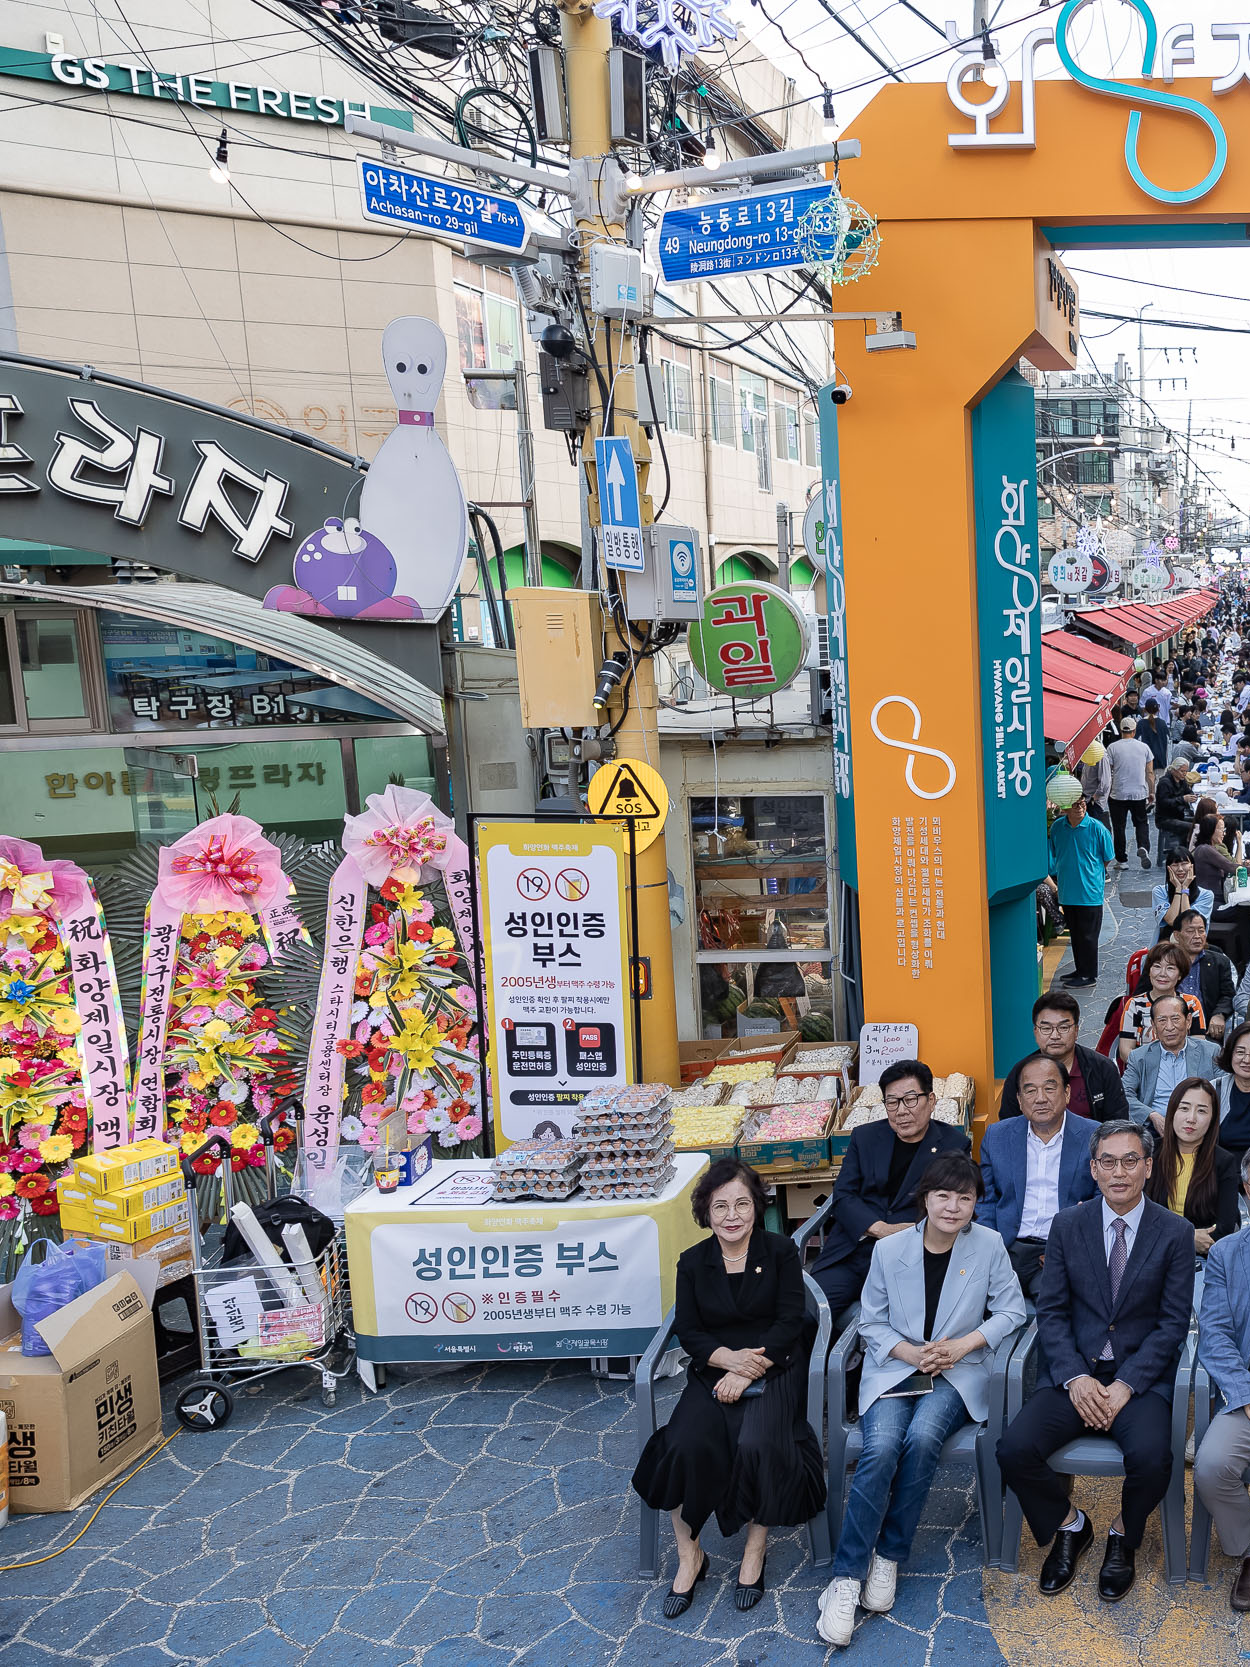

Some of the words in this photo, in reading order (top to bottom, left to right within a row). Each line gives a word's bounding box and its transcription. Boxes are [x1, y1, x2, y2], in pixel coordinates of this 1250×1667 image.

[51, 53, 108, 91] GS
[128, 63, 216, 108] THE
[229, 80, 372, 126] FRESH
[366, 169, 493, 224] 아차산로29길
[370, 197, 441, 226] Achasan-ro
[445, 215, 478, 235] 29-gil
[814, 214, 832, 232] 53
[664, 236, 680, 254] 49
[688, 231, 771, 255] Neungdong-ro
[604, 530, 641, 561] 일방통행
[711, 592, 777, 688] 과일
[132, 694, 234, 721] 탁구장
[615, 803, 643, 814] SOS
[919, 816, 929, 866] 기성세대와
[68, 915, 102, 942] 祝
[328, 893, 359, 976] 신한은행
[504, 911, 606, 939] 성인인증
[532, 942, 582, 969] 부스
[141, 925, 178, 1066] 광진구전통시장
[508, 995, 536, 1005] 성인인증
[73, 952, 125, 1108] 화양제일시장
[504, 1019, 509, 1028] 1
[565, 1019, 572, 1029] 2
[575, 1062, 608, 1072] 성인인증
[527, 1093, 555, 1102] 성인인증
[304, 1105, 336, 1170] 윤성일
[411, 1245, 544, 1282] 성인인증
[555, 1241, 620, 1277] 부스
[483, 1305, 557, 1322] 2005년생부터
[559, 1304, 583, 1319] 맥주
[585, 1303, 607, 1317] 수령
[610, 1302, 632, 1316] 가능
[444, 1344, 477, 1353] 서울특별시
[95, 1381, 134, 1432] 민생
[98, 1408, 136, 1446] 키친타월
[8, 1431, 36, 1459] 생
